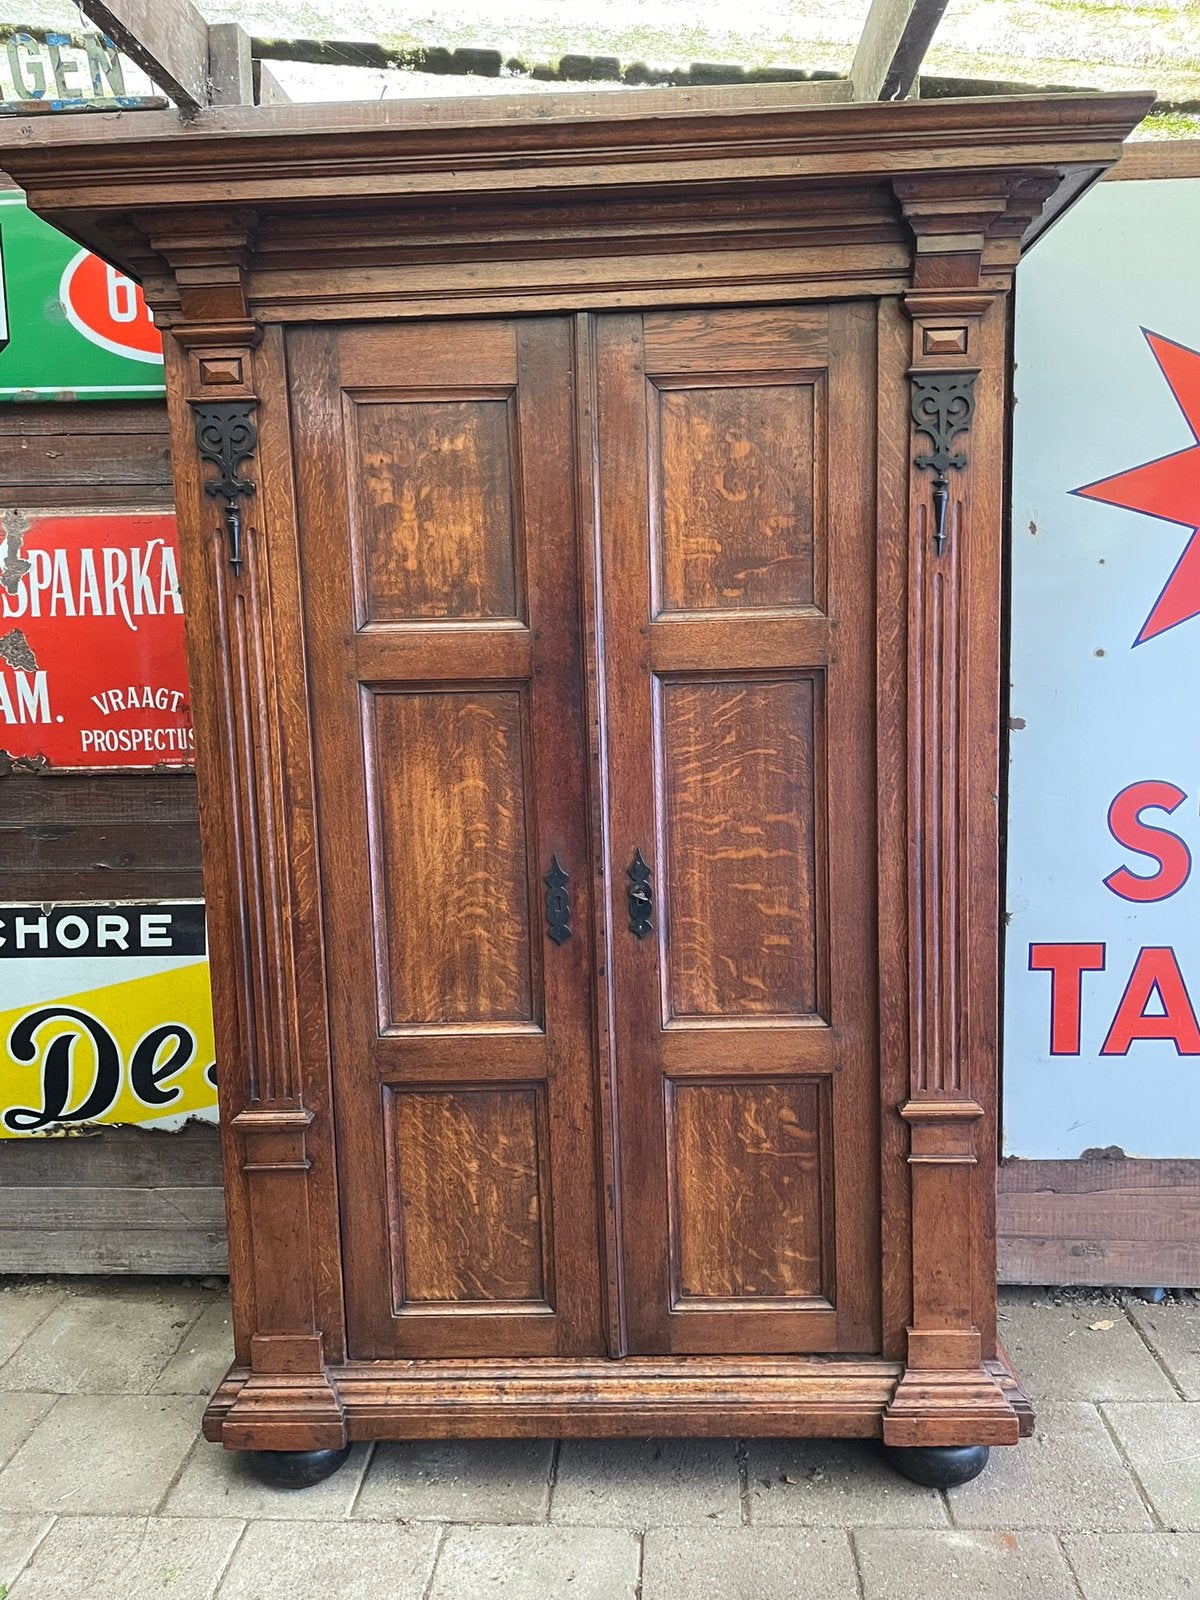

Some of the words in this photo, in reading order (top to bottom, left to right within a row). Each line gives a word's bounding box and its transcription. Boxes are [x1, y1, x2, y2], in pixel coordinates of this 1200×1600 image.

[0, 33, 126, 100] GEN
[0, 537, 184, 631] SPAARKA
[80, 727, 195, 752] PROSPECTUS
[90, 686, 184, 716] VRAAGT
[1102, 779, 1200, 904] S
[0, 914, 173, 950] HORE
[1028, 942, 1200, 1056] TA
[4, 1006, 218, 1131] De
